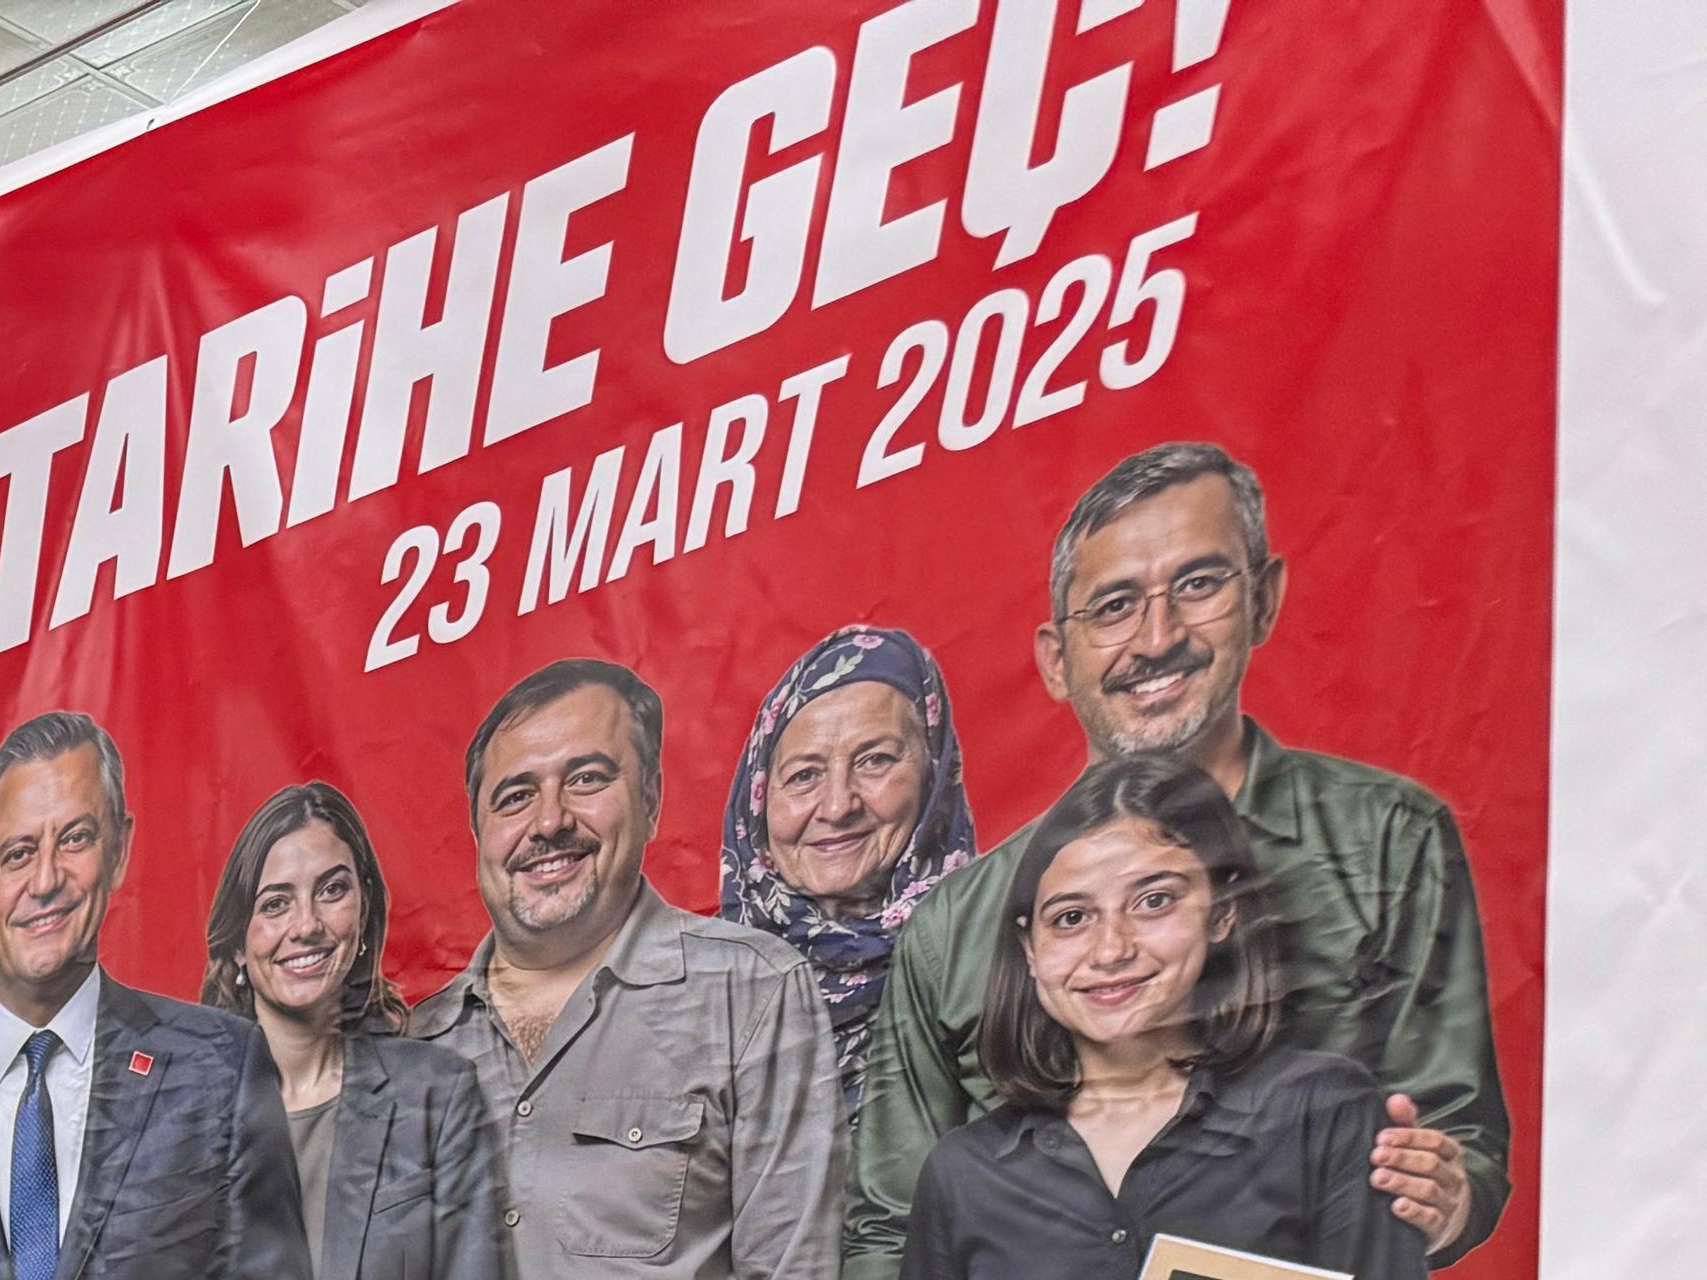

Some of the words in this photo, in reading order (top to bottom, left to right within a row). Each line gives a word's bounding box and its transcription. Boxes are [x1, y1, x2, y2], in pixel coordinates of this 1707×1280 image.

[663, 0, 1232, 364] GEÇ!
[364, 501, 502, 673] 23
[517, 353, 852, 616] MART
[856, 211, 1199, 490] 2025
